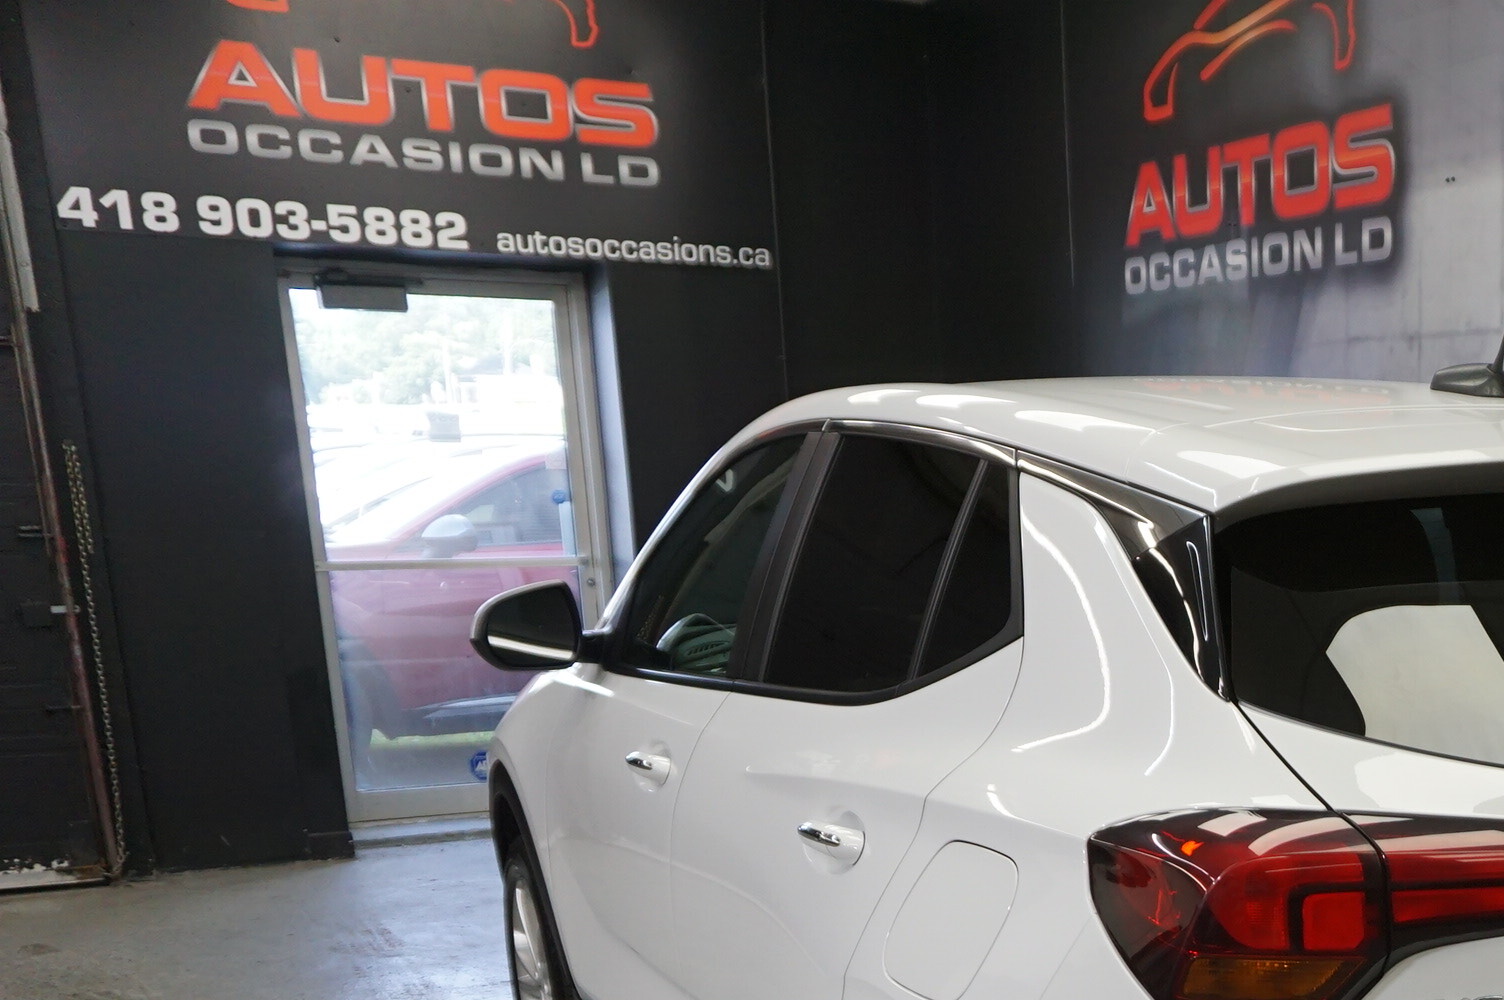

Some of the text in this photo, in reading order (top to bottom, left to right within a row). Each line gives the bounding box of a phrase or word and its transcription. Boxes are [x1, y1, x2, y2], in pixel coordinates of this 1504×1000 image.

[187, 38, 661, 149] AUTOS
[187, 118, 661, 188] OCCASION LD
[1124, 102, 1396, 249] AUTOS
[56, 186, 470, 251] 418 903-5882
[495, 228, 774, 270] autosoccasions.ca
[1124, 215, 1393, 296] OCCASION LD
